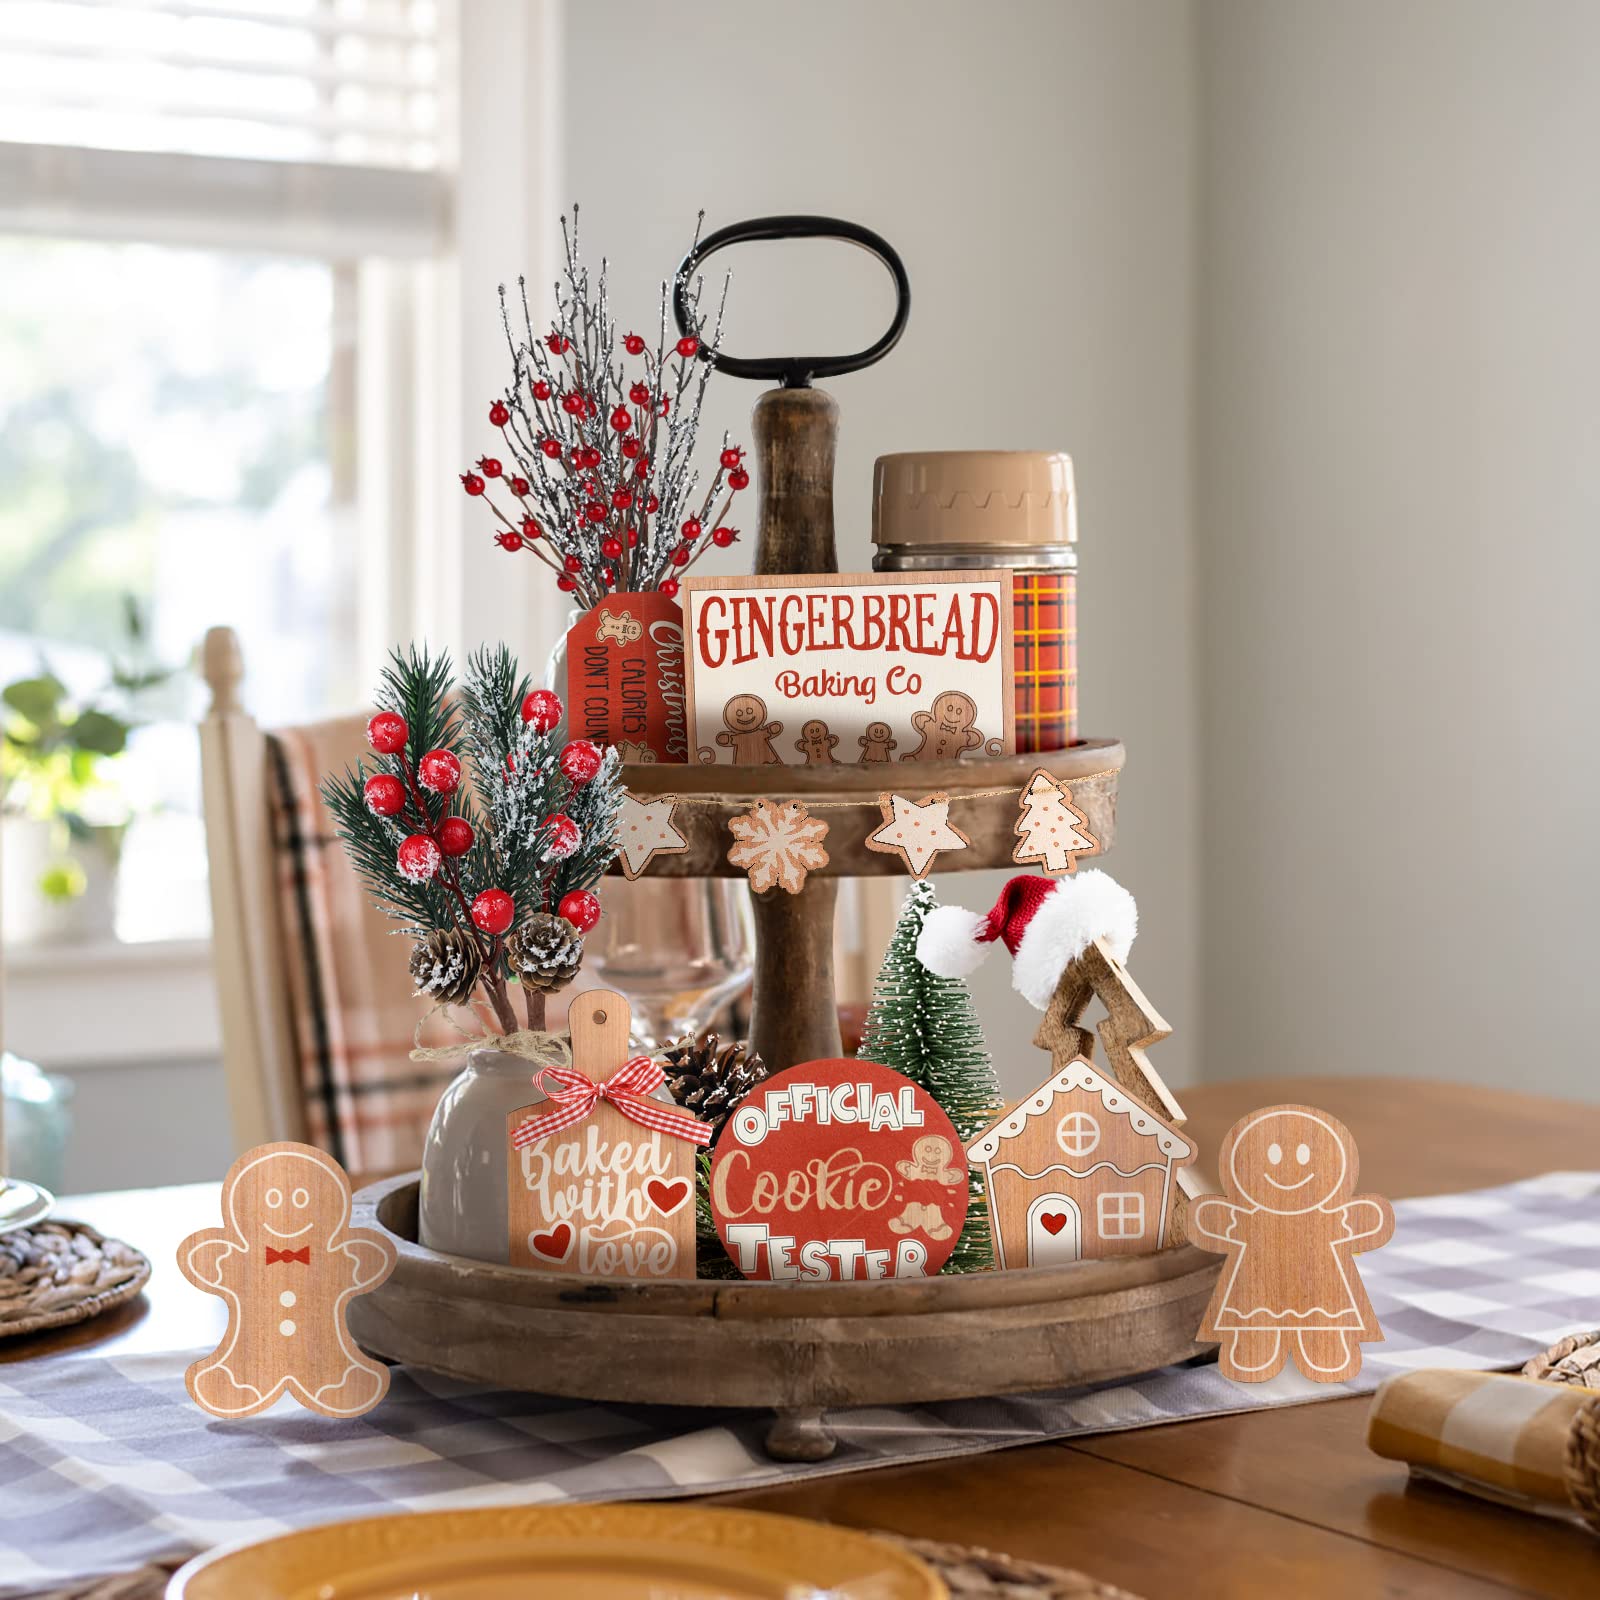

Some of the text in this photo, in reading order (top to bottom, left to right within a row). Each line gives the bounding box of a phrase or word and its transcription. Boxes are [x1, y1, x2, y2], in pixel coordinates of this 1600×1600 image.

[697, 592, 999, 668] GINGERBREAD
[584, 646, 609, 690] DON'T
[620, 658, 647, 734] CALORIES
[648, 620, 688, 761] Christmas
[775, 665, 922, 704] Baking Co
[733, 1082, 925, 1146] OFFICIAL
[521, 1115, 672, 1190] Baked
[713, 1147, 893, 1218] Cookie
[540, 1174, 652, 1222] with
[726, 1223, 927, 1281] TESTER
